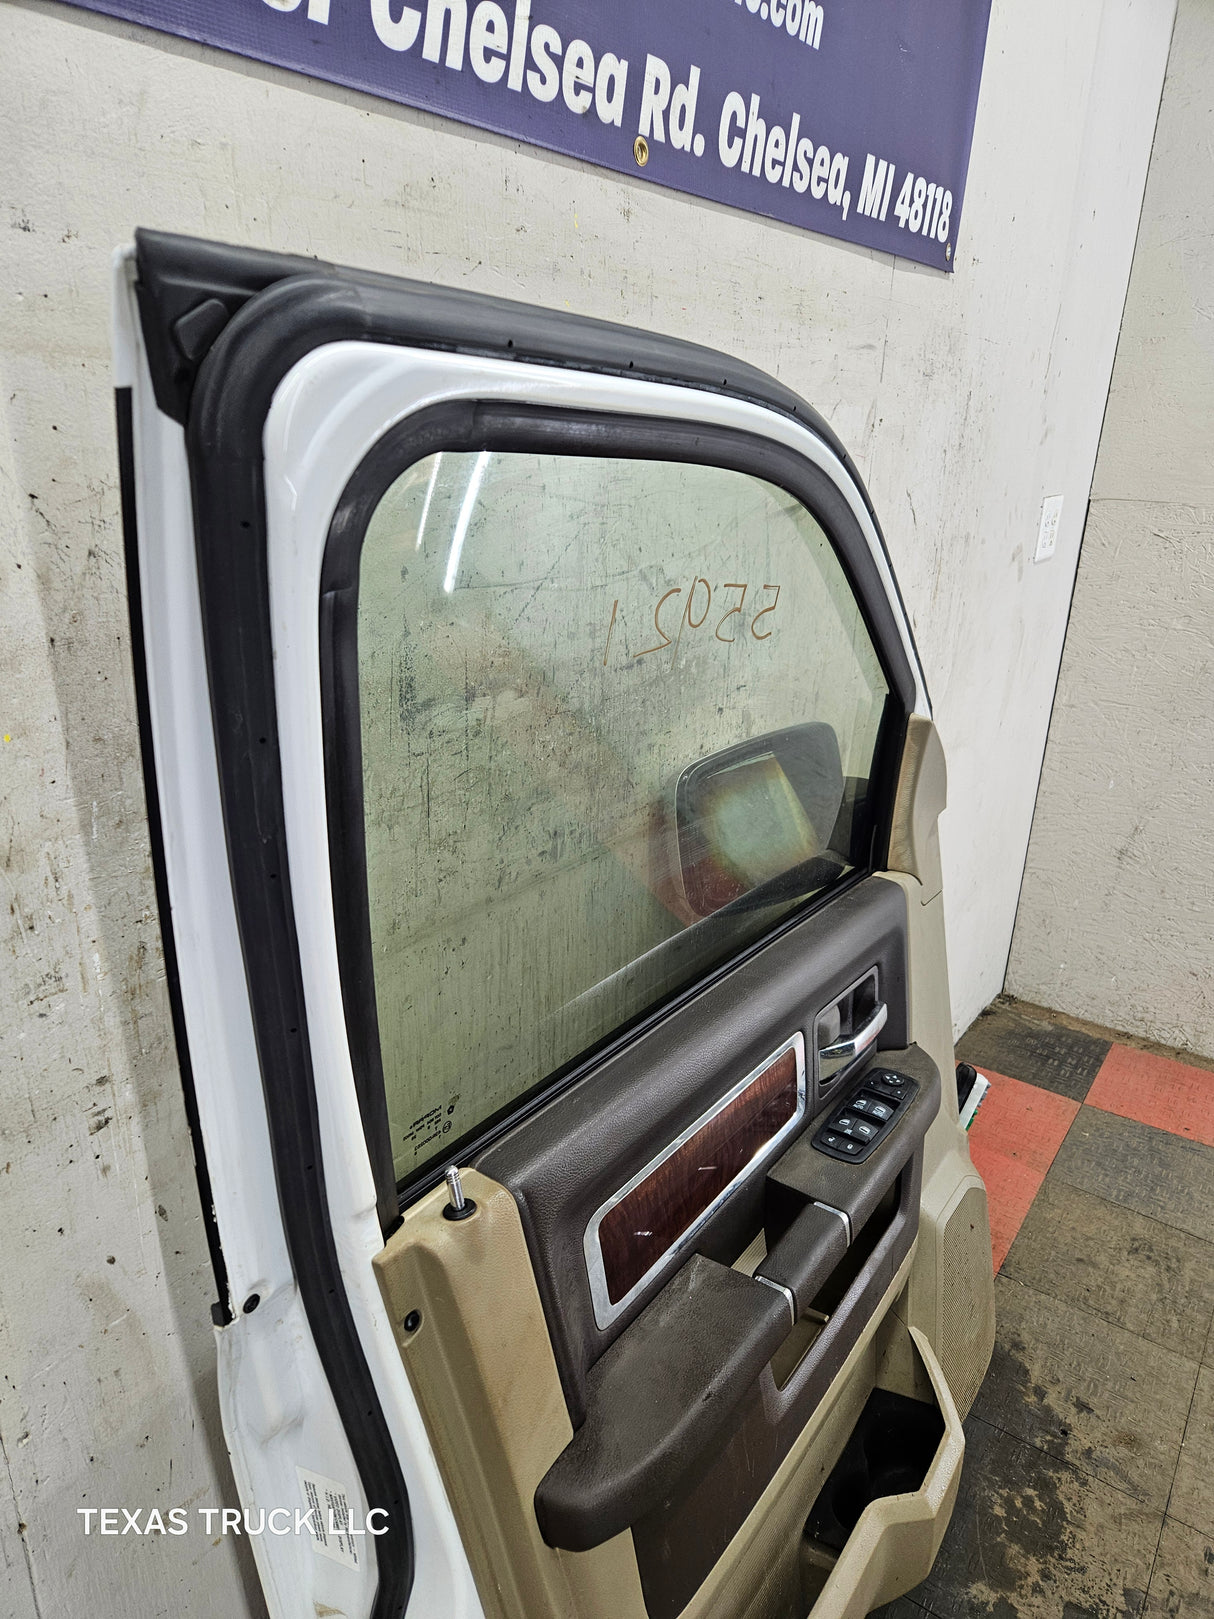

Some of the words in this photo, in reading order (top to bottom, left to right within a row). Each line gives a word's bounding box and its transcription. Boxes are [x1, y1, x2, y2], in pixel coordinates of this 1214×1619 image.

[734, 0, 824, 50] .com
[638, 53, 705, 157] Rd.
[718, 91, 851, 221] Chelsea,
[856, 152, 896, 221] MI
[894, 171, 953, 243] 48118
